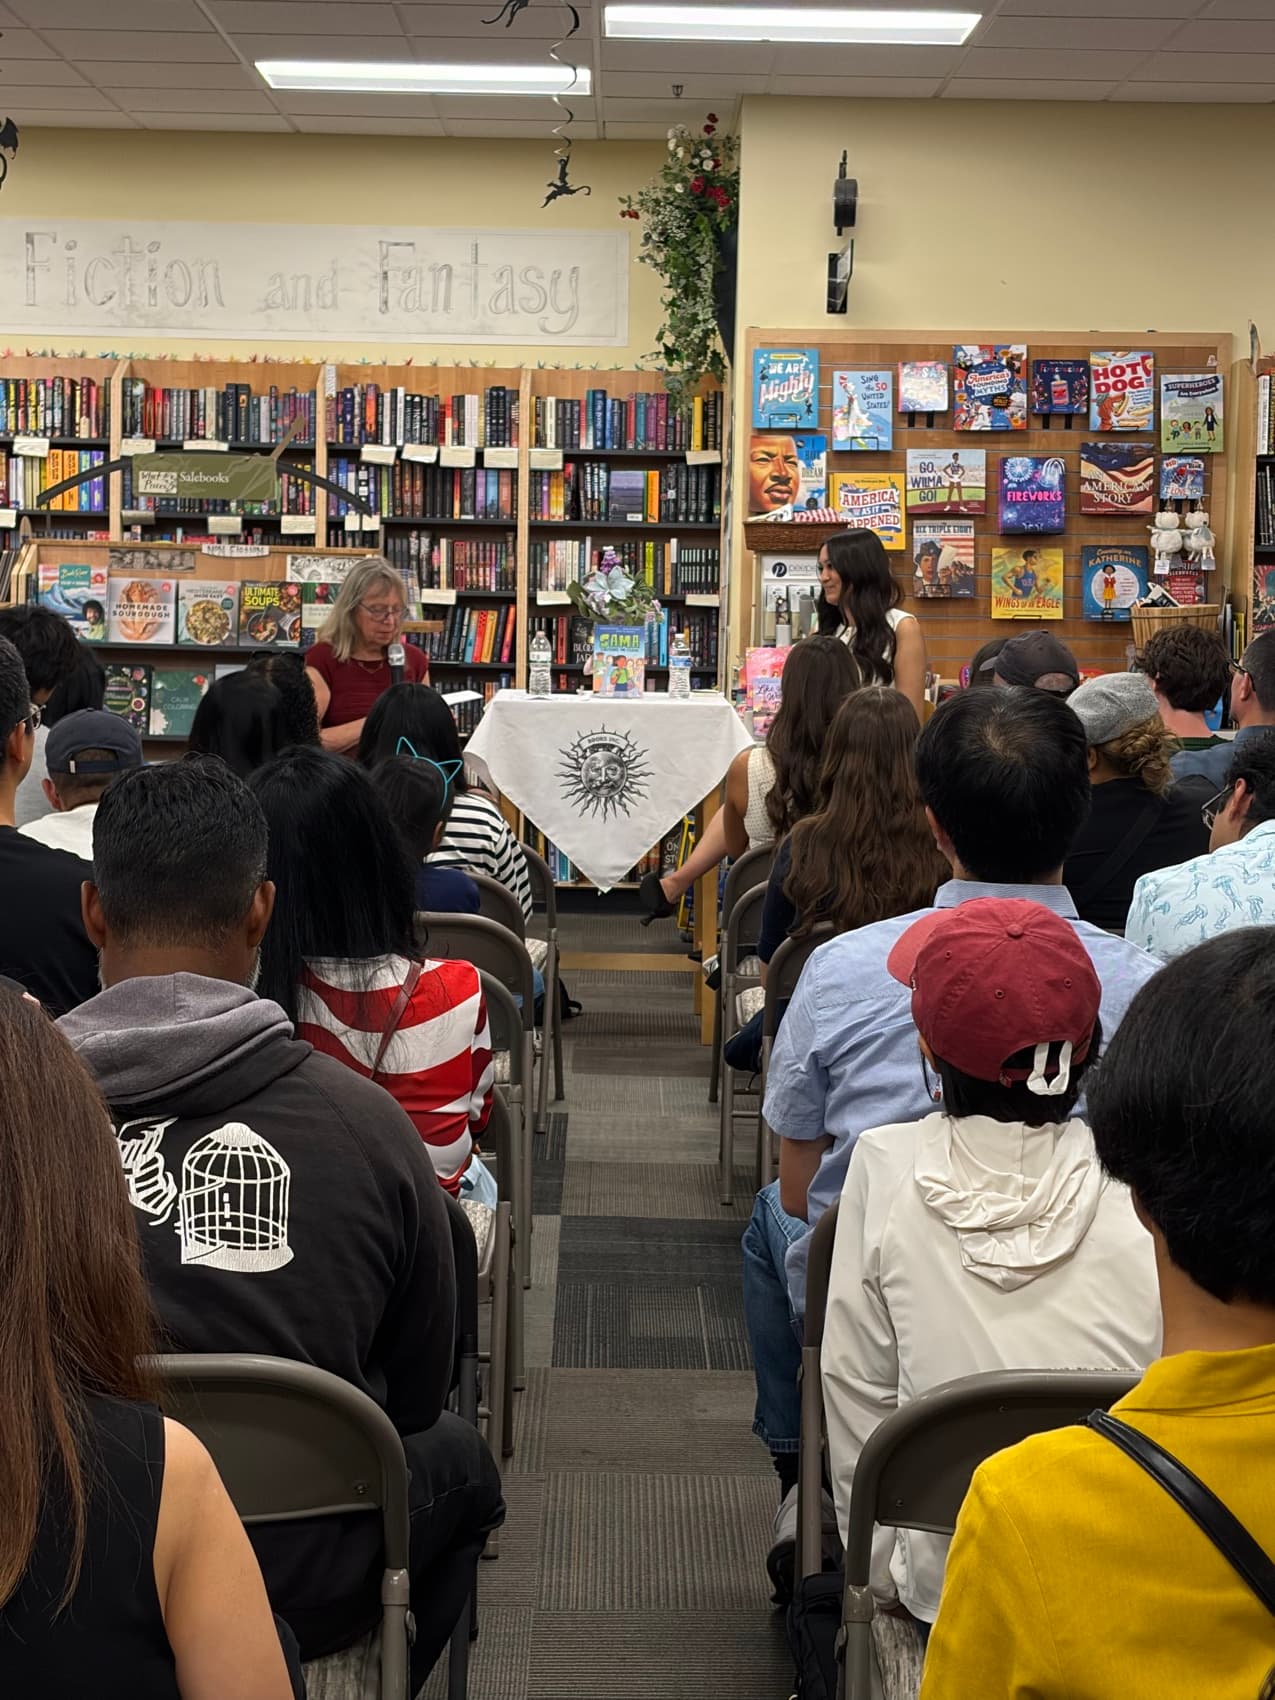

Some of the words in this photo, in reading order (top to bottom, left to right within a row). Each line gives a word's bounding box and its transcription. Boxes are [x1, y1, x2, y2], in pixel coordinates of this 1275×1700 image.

[24, 231, 226, 308] Fiction
[262, 257, 339, 312] and
[377, 234, 581, 335] Fantasy
[769, 362, 783, 374] WE
[785, 362, 806, 374] ARE
[1093, 362, 1141, 381] HOT
[759, 371, 815, 410] Mighty
[875, 382, 888, 391] 50
[1095, 376, 1145, 393] DOG
[179, 471, 230, 483] Salebooks
[1083, 480, 1151, 492] AMERICAN
[841, 490, 896, 507] AMERICA
[919, 489, 937, 502] GO!
[1006, 490, 1062, 502] FIREWORKS
[1092, 493, 1133, 505] STORY
[245, 587, 279, 596] ULTIMATE
[244, 596, 280, 606] SOUPS
[112, 610, 170, 618] SOURDOUGH
